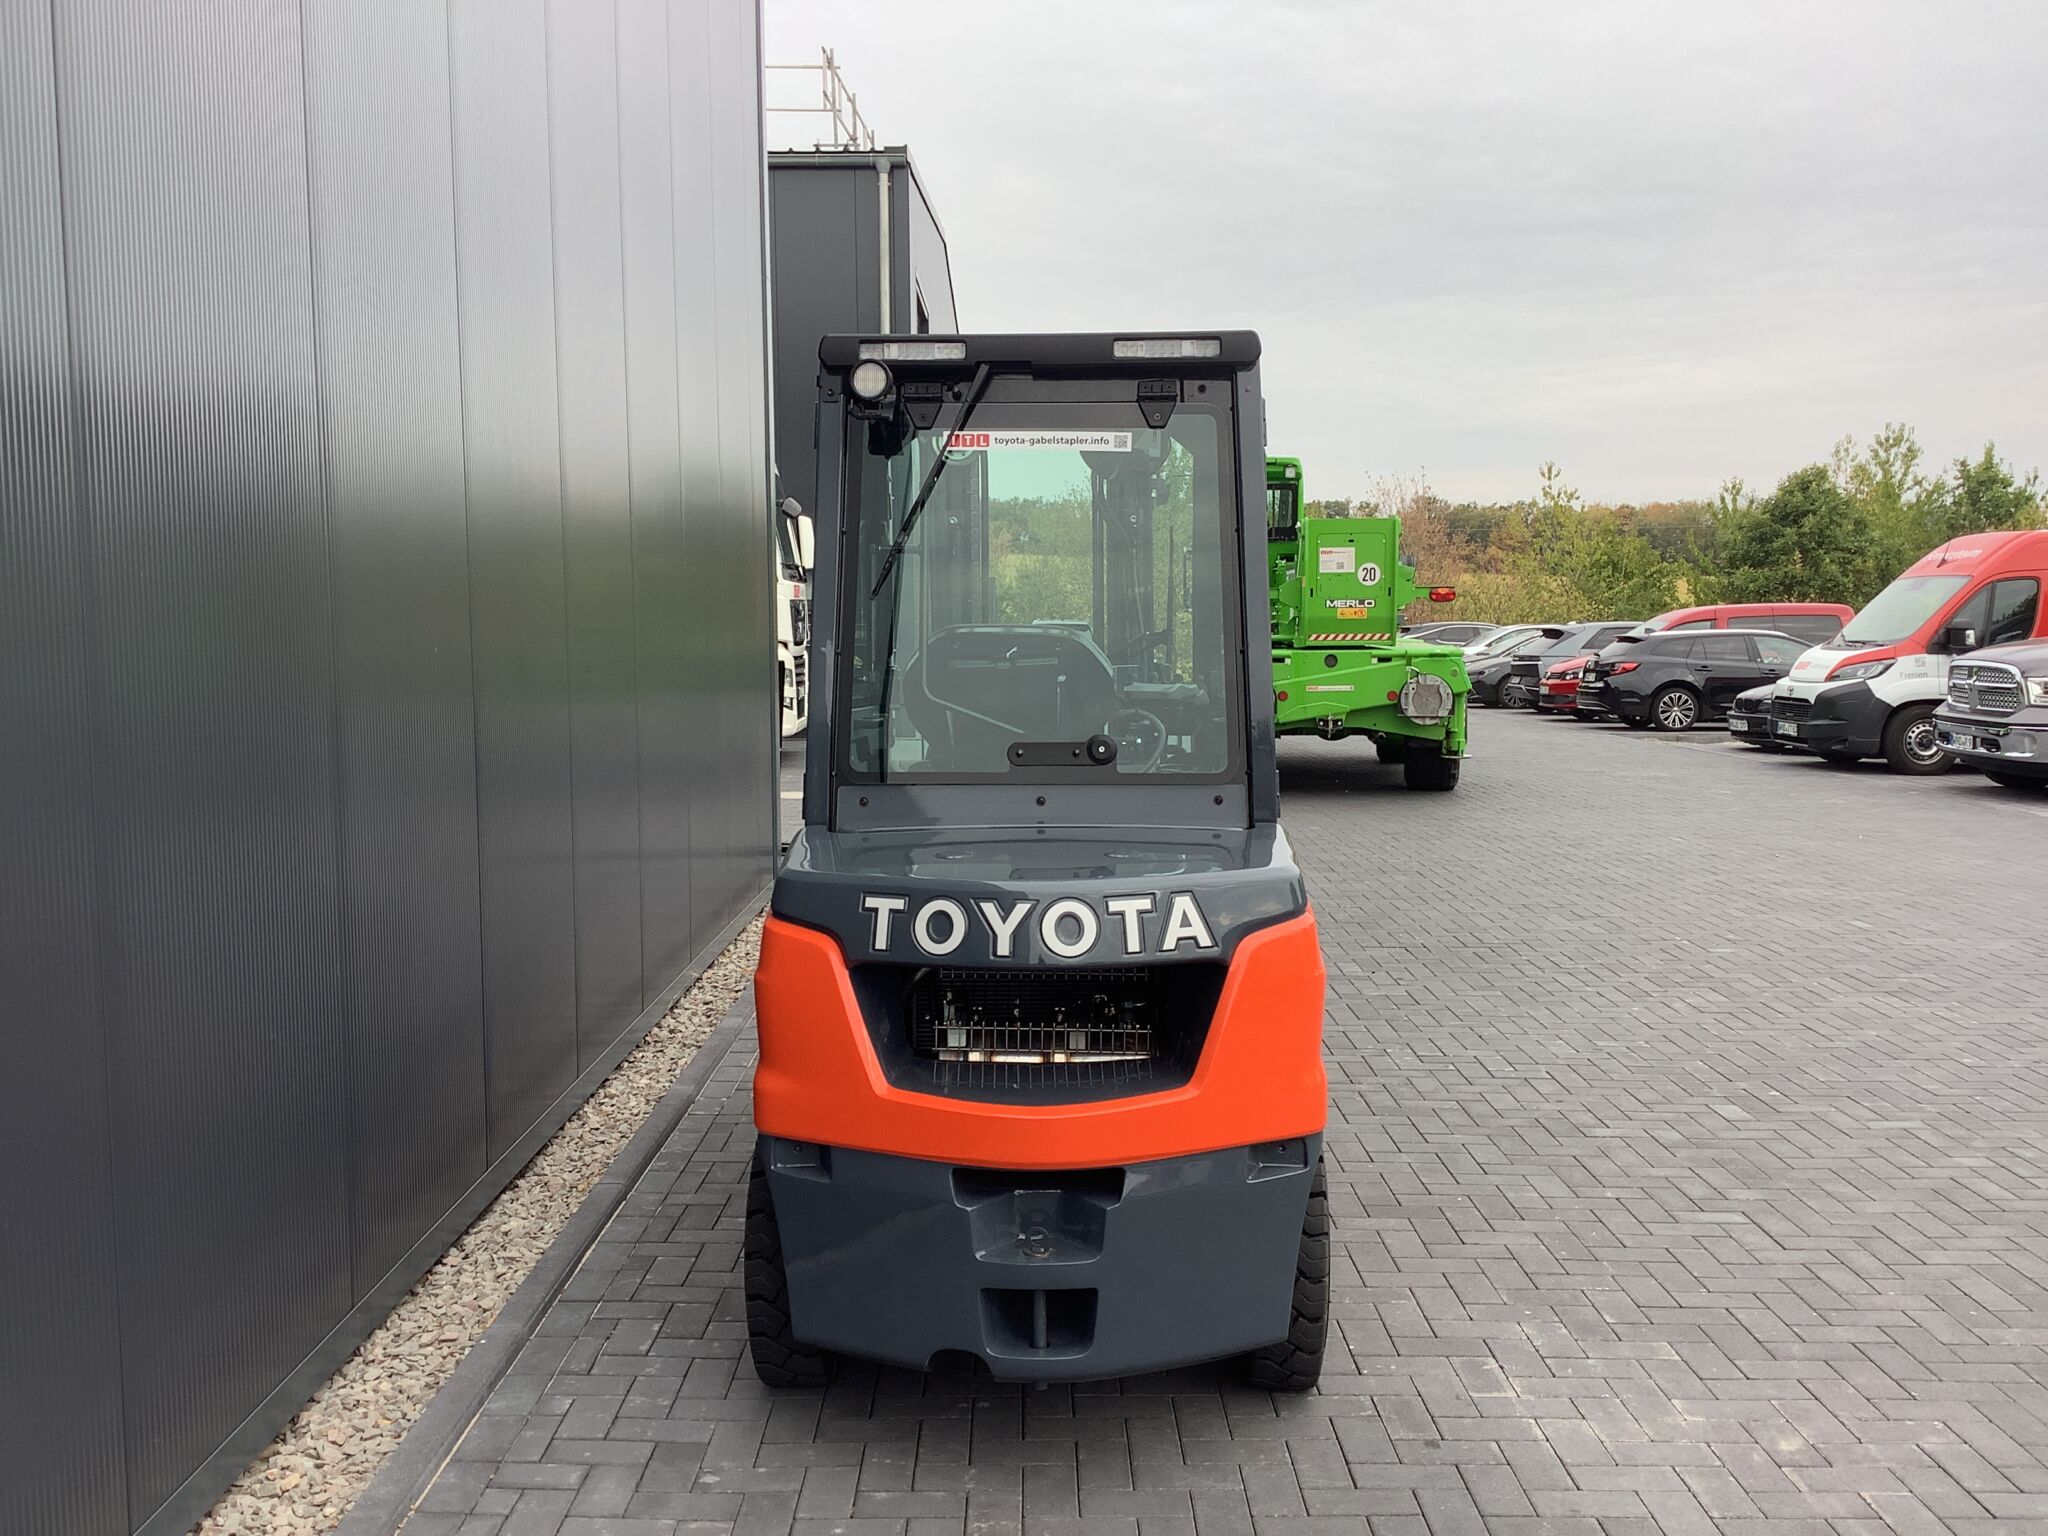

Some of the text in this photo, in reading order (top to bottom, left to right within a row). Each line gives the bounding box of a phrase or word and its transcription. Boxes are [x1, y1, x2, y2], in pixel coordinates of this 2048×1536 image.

[950, 435, 1110, 447] ITL toyota-gabelstapler.info
[1362, 567, 1376, 582] 20
[1326, 599, 1375, 608] MERLO
[862, 893, 1218, 959] TOYOTA
